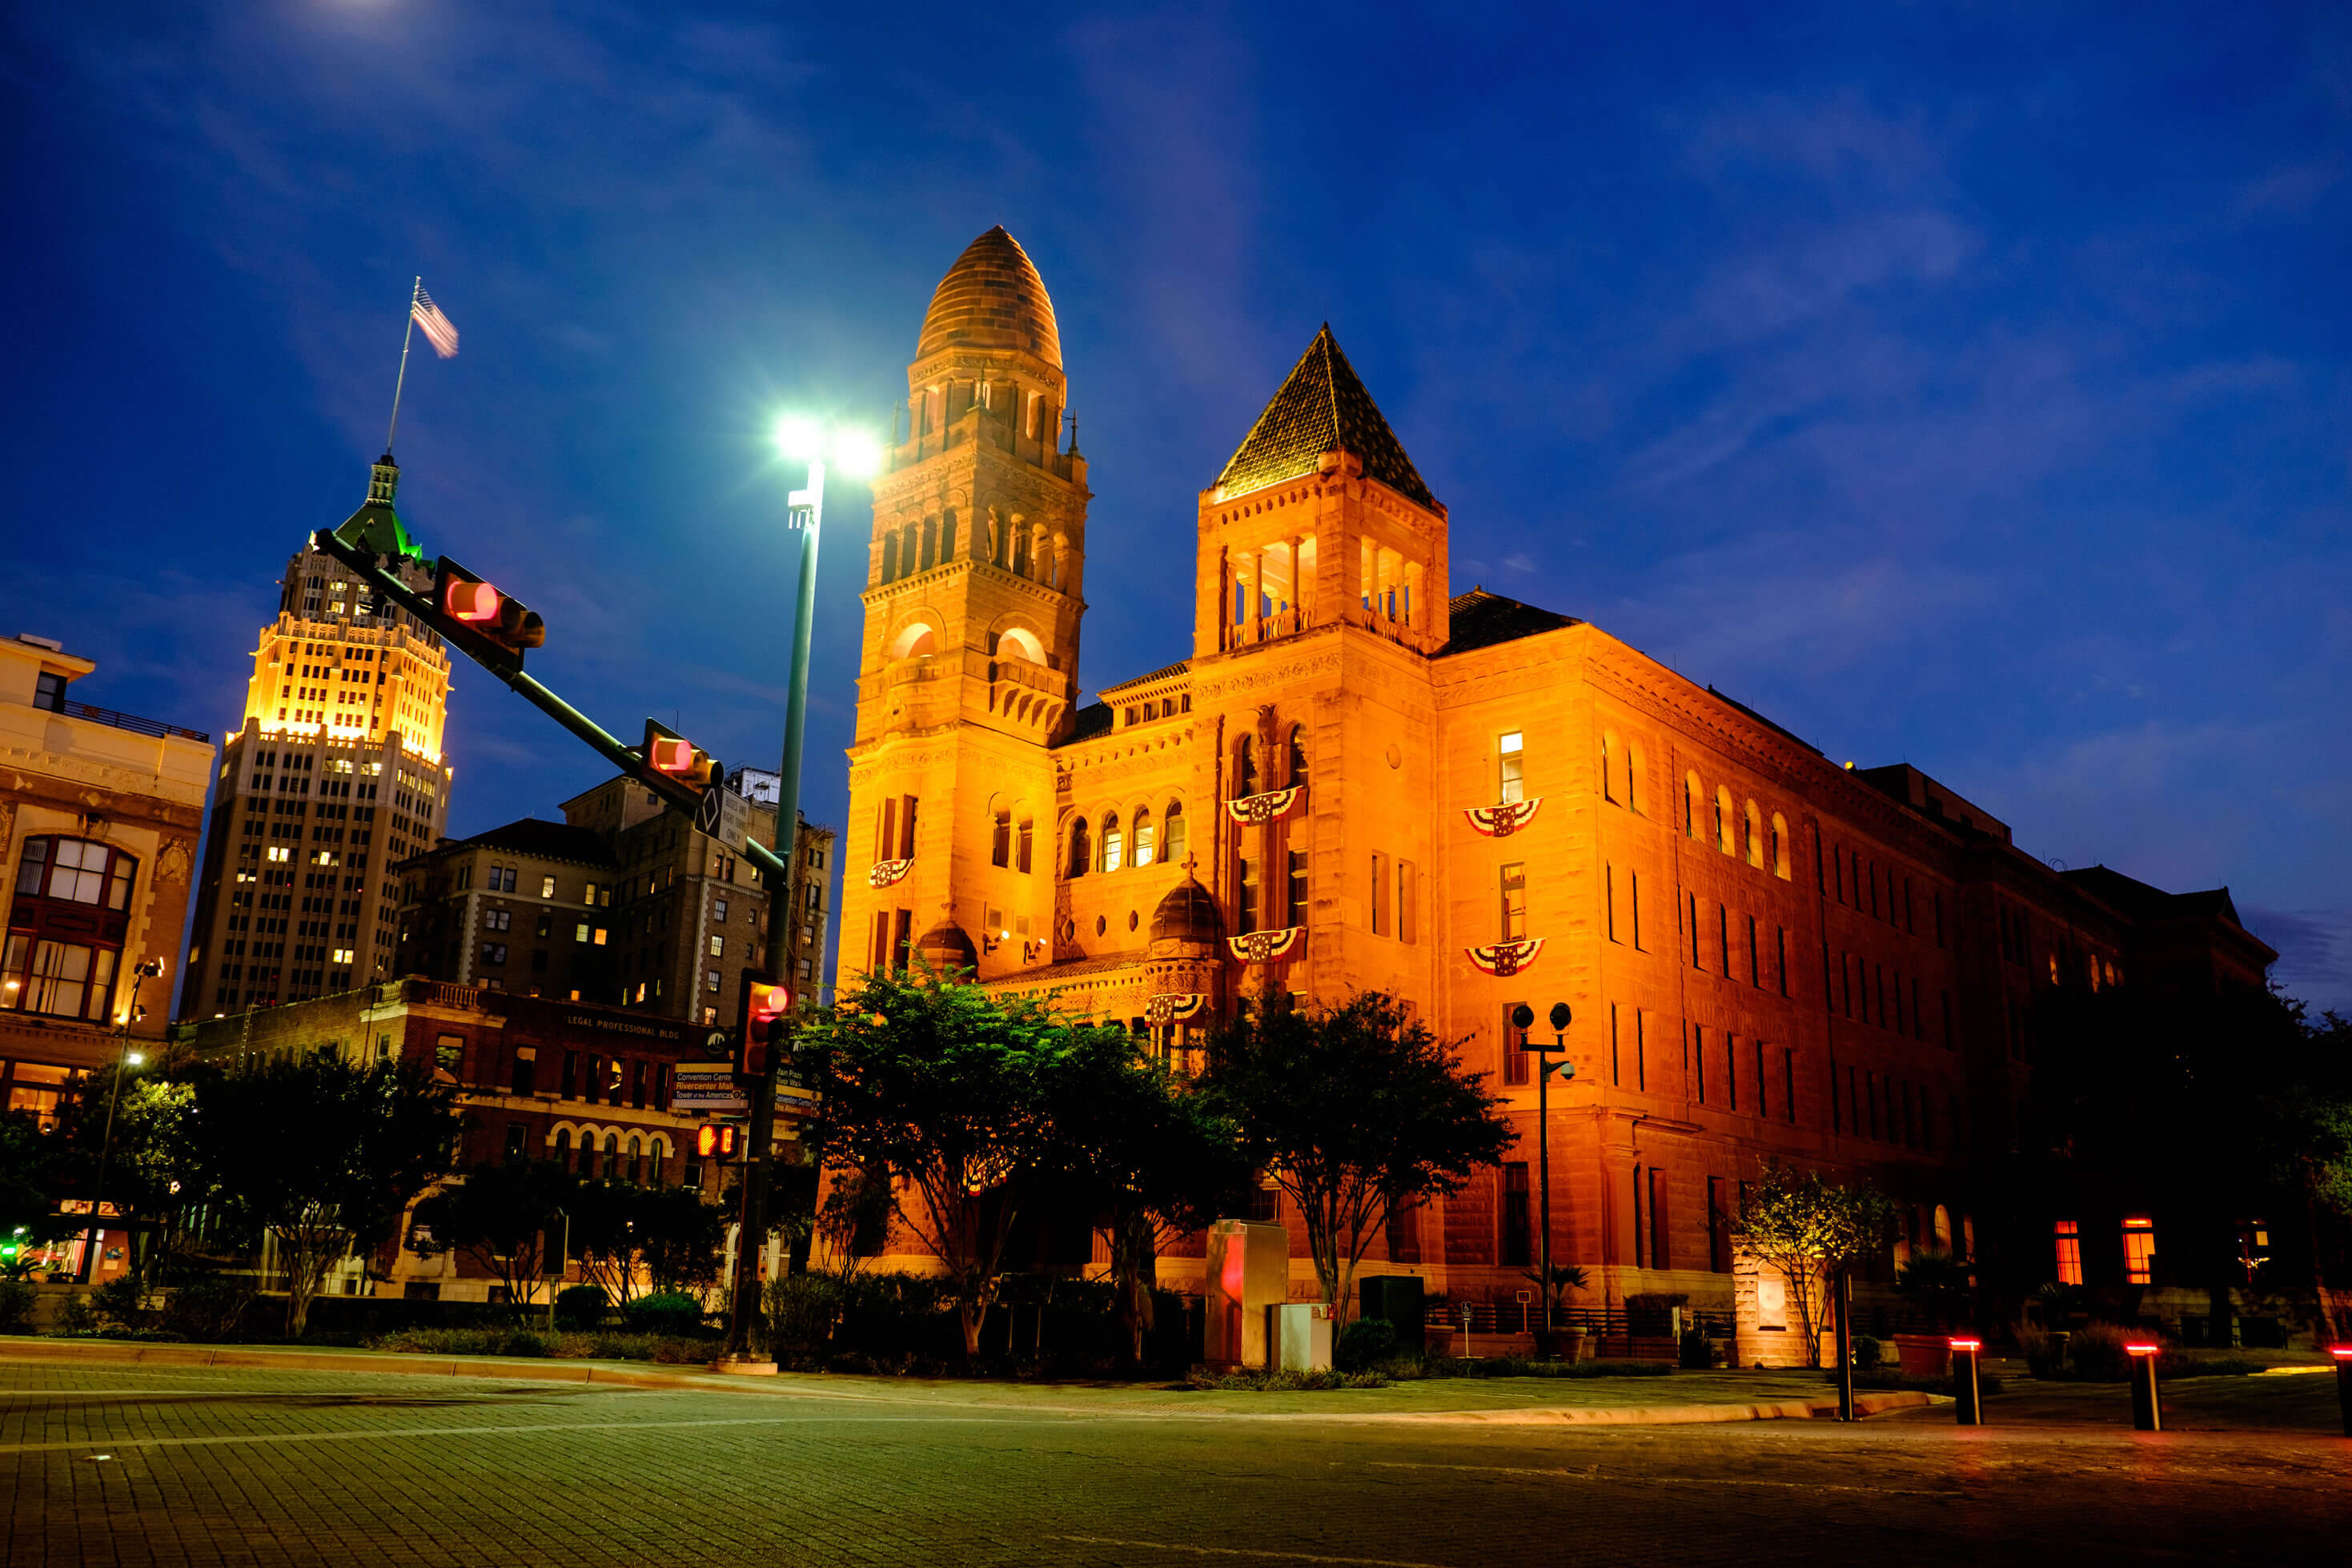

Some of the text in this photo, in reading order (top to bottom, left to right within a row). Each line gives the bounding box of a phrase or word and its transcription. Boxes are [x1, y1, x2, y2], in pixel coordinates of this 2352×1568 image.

[567, 1014, 680, 1040] LEGAL PROFESSIONAL BLDG
[676, 1073, 732, 1081] Convention Cente
[676, 1081, 733, 1089] Rivercenter Mall
[676, 1091, 692, 1099] Tower
[775, 1102, 785, 1113] The
